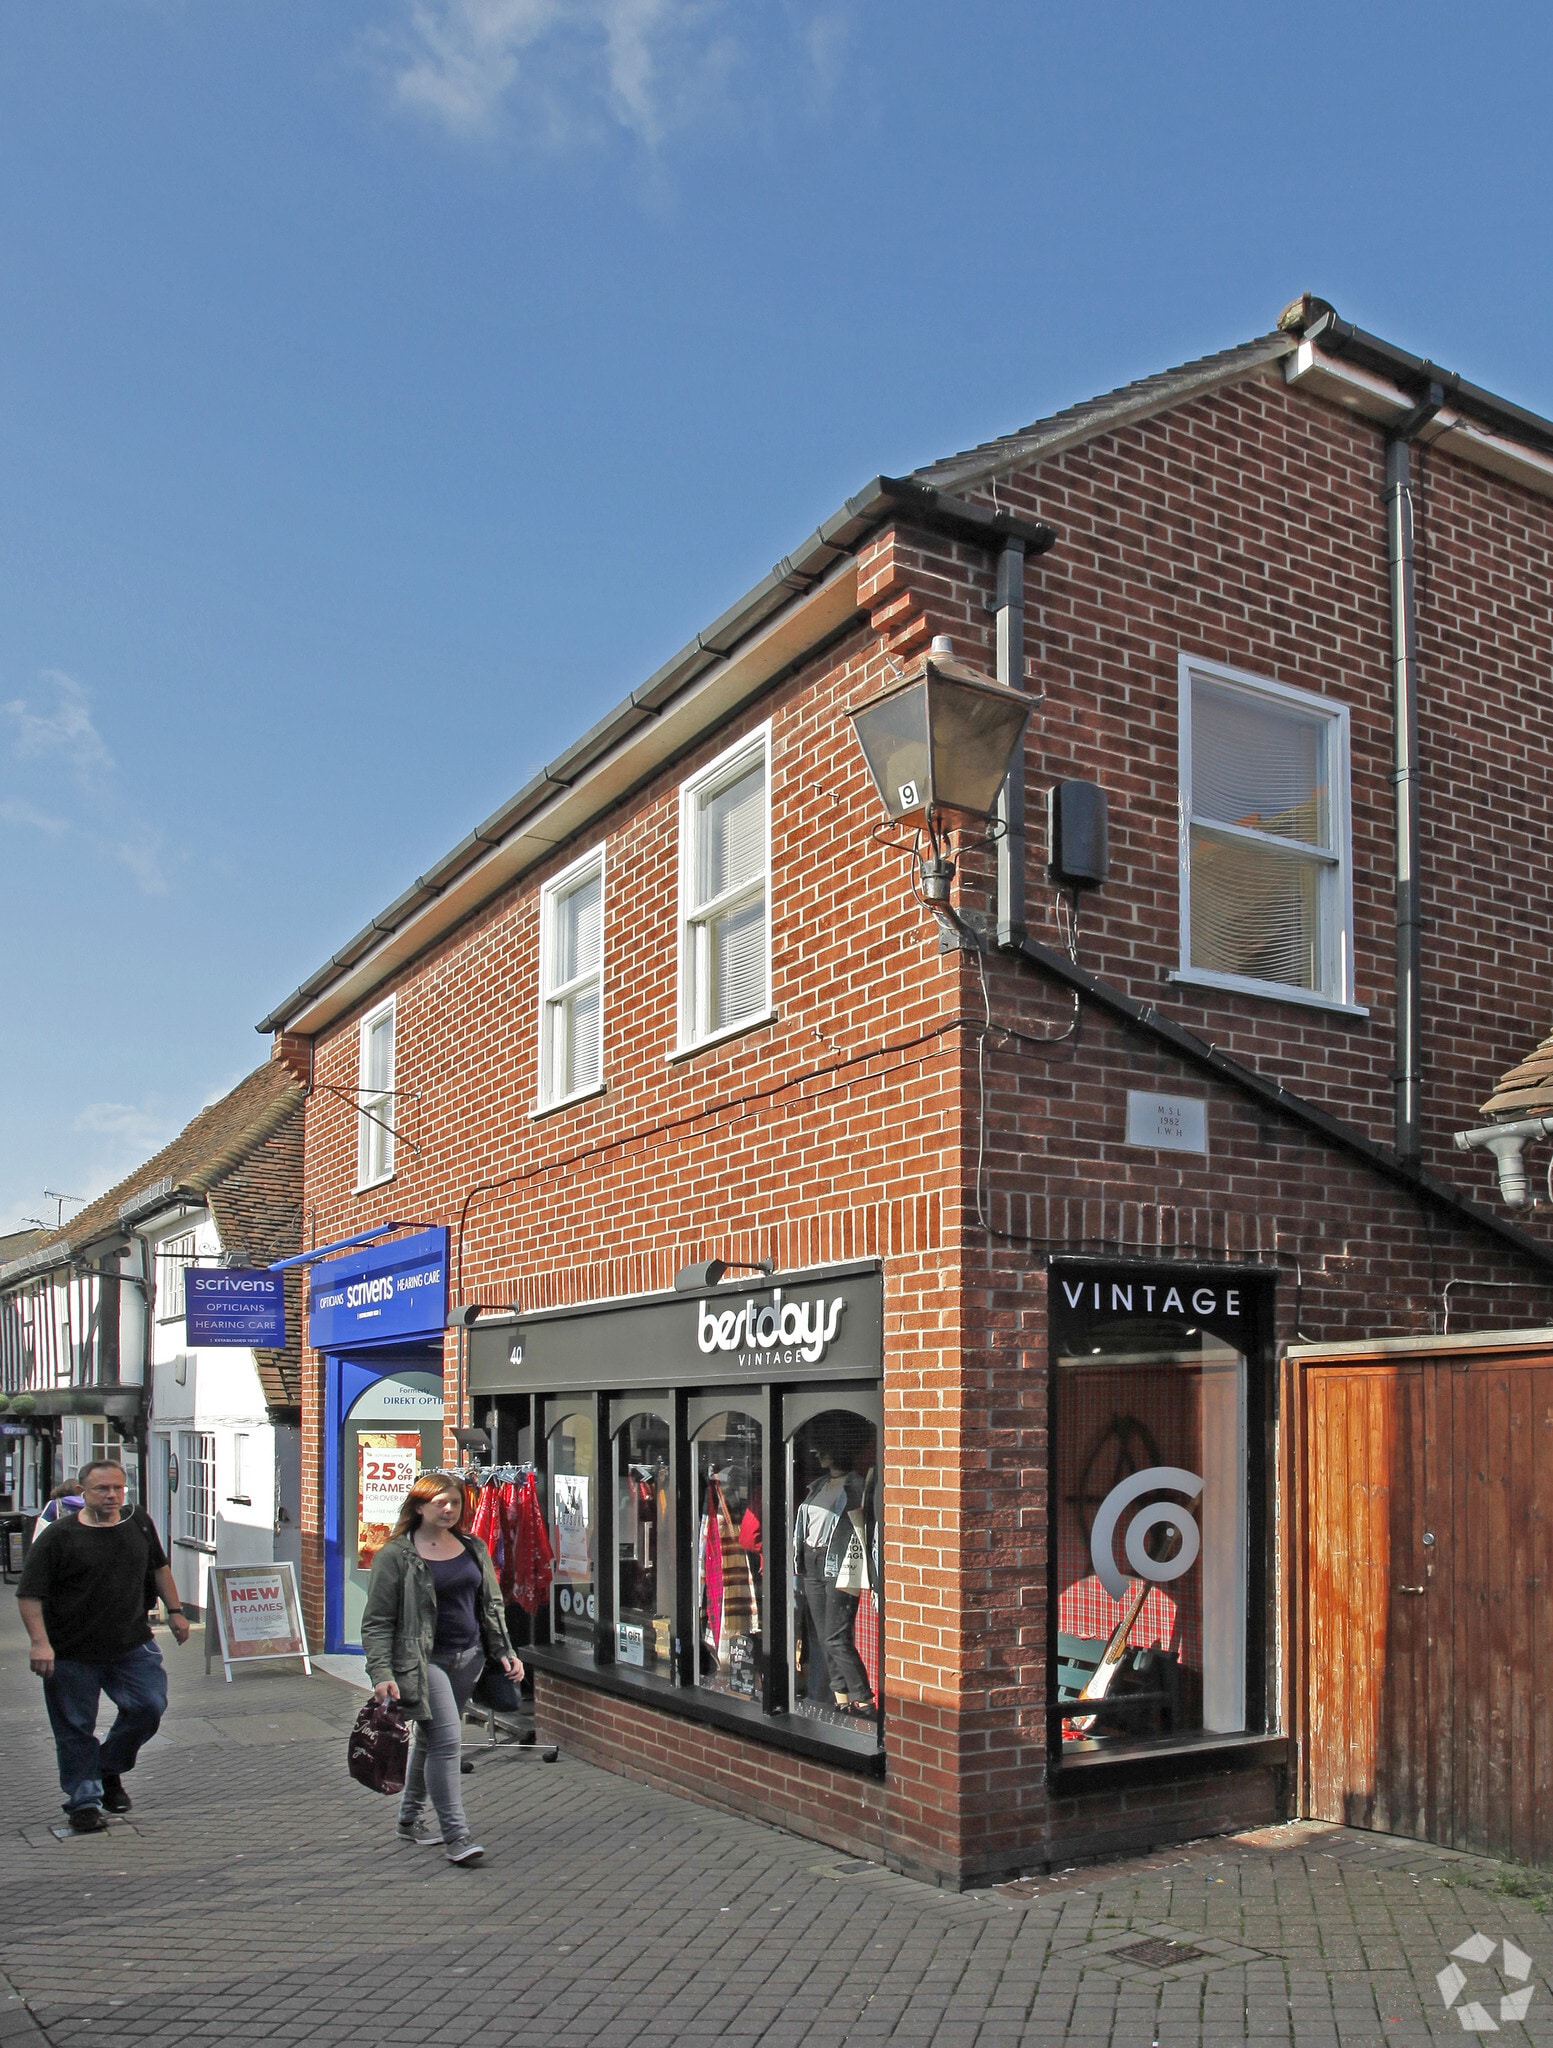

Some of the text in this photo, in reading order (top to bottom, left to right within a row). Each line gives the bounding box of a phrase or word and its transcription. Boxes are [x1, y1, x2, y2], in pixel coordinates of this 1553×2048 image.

[903, 785, 914, 804] 9
[1160, 1117, 1179, 1126] 1982
[195, 1276, 275, 1292] scrivens
[320, 1269, 440, 1309] OPTICIANS scrivens HEARING CARE
[1062, 1281, 1240, 1316] VINTAGE
[206, 1303, 265, 1312] OPTICIANS
[195, 1320, 276, 1330] HEARING CARE
[510, 1346, 522, 1365] 40
[738, 1350, 801, 1367] VINTAGE
[399, 1387, 431, 1395] Formerly
[383, 1397, 416, 1405] DIREKT
[4, 1427, 28, 1435] OPEN
[366, 1462, 412, 1480] 25%
[366, 1483, 412, 1493] FRAMES
[230, 1586, 280, 1602] NEW
[233, 1602, 284, 1614] FRAMES
[627, 1631, 641, 1642] GIFT
